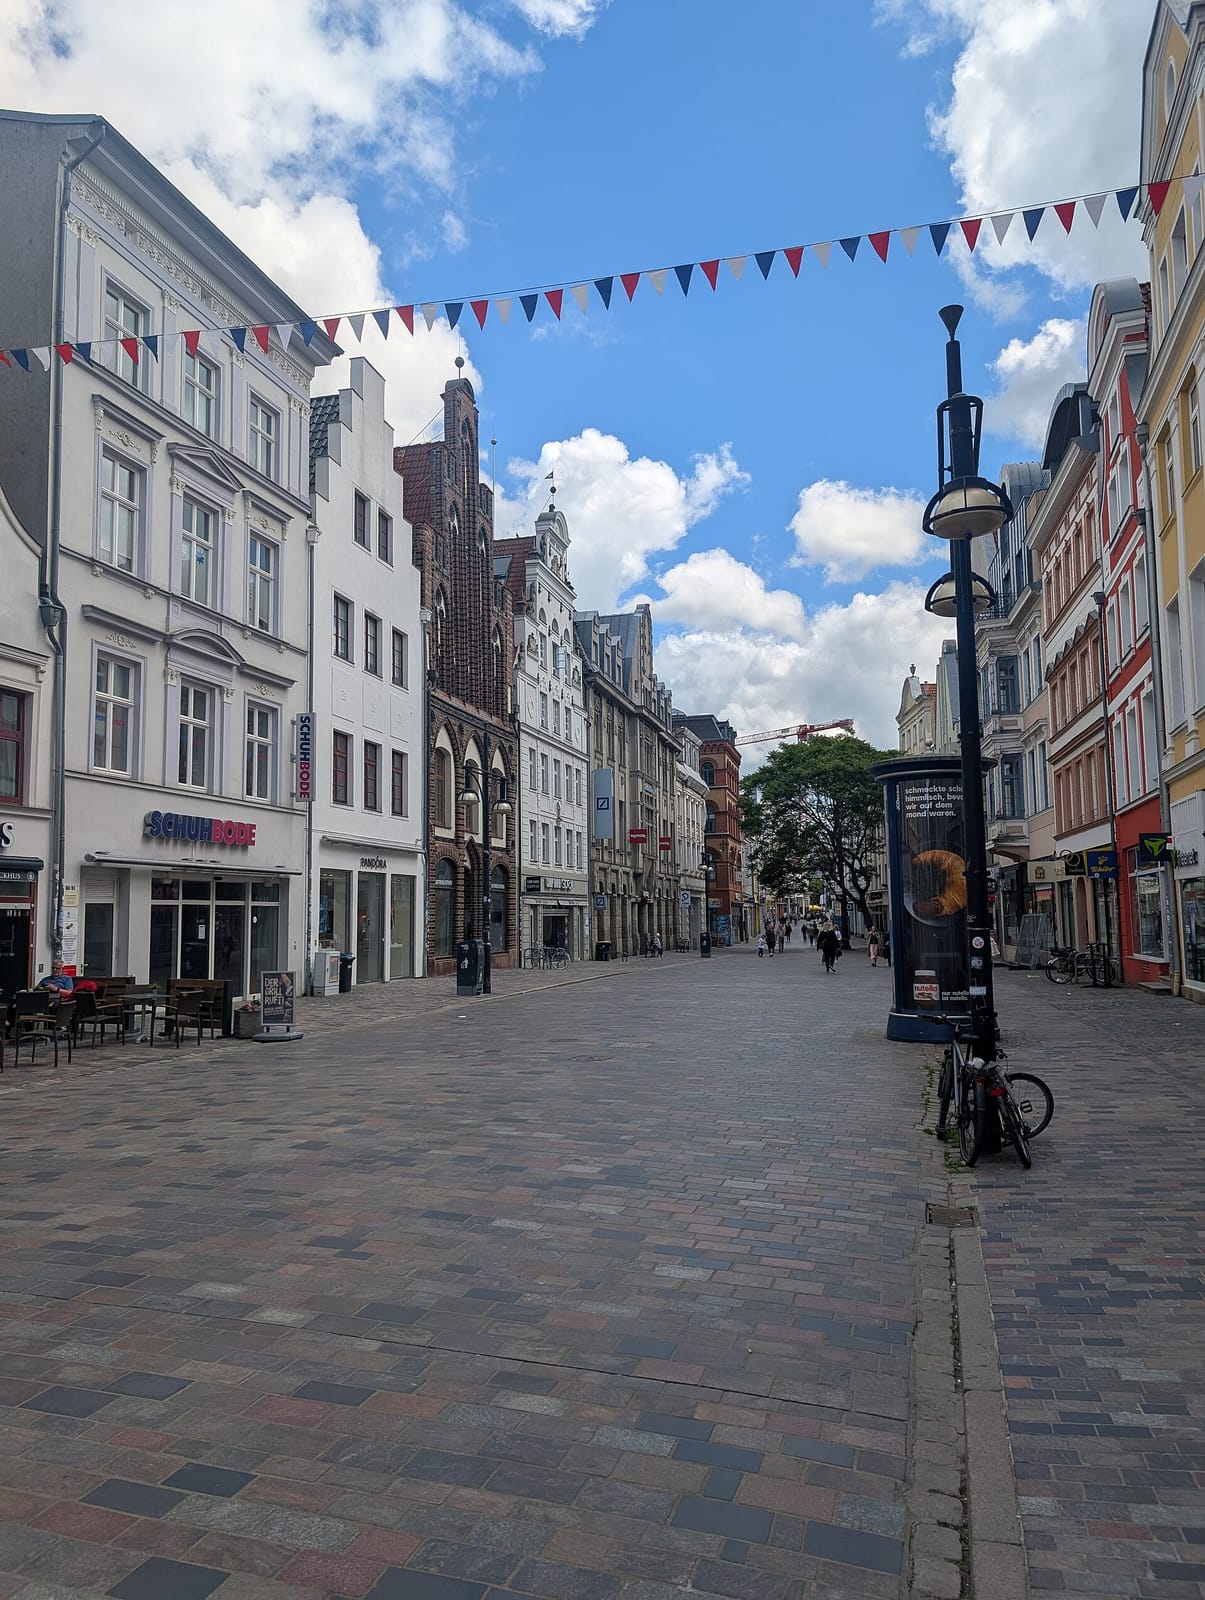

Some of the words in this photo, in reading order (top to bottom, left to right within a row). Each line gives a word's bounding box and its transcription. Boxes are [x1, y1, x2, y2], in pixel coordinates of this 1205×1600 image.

[300, 715, 311, 799] SCHUHBODE
[935, 801, 953, 809] dem
[905, 810, 927, 818] mond
[145, 810, 257, 847] SCHUHBODE
[264, 977, 279, 987] DER
[264, 987, 284, 996] GRILL
